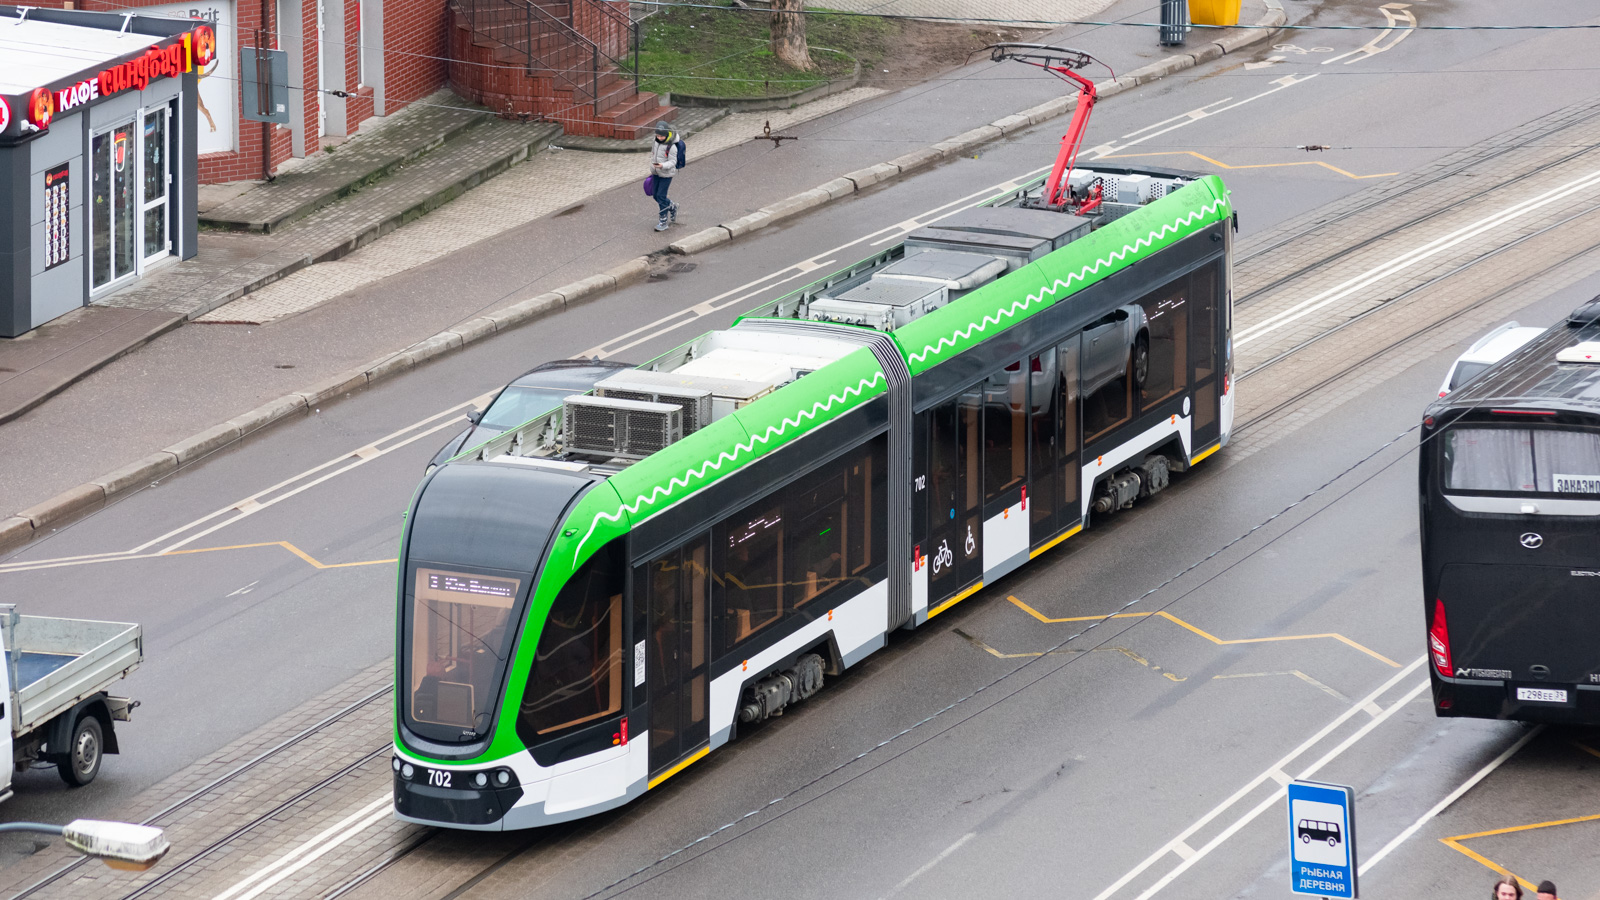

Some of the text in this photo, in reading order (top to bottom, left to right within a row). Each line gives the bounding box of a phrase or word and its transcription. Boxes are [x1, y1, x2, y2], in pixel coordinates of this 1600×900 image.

[189, 7, 220, 21] Brit
[59, 77, 99, 112] КАФЕ
[914, 474, 926, 493] 702
[427, 768, 452, 788] 702
[1300, 866, 1343, 880] РЫБНАЯ
[1299, 878, 1346, 893] ДЕРЕВНЯ
